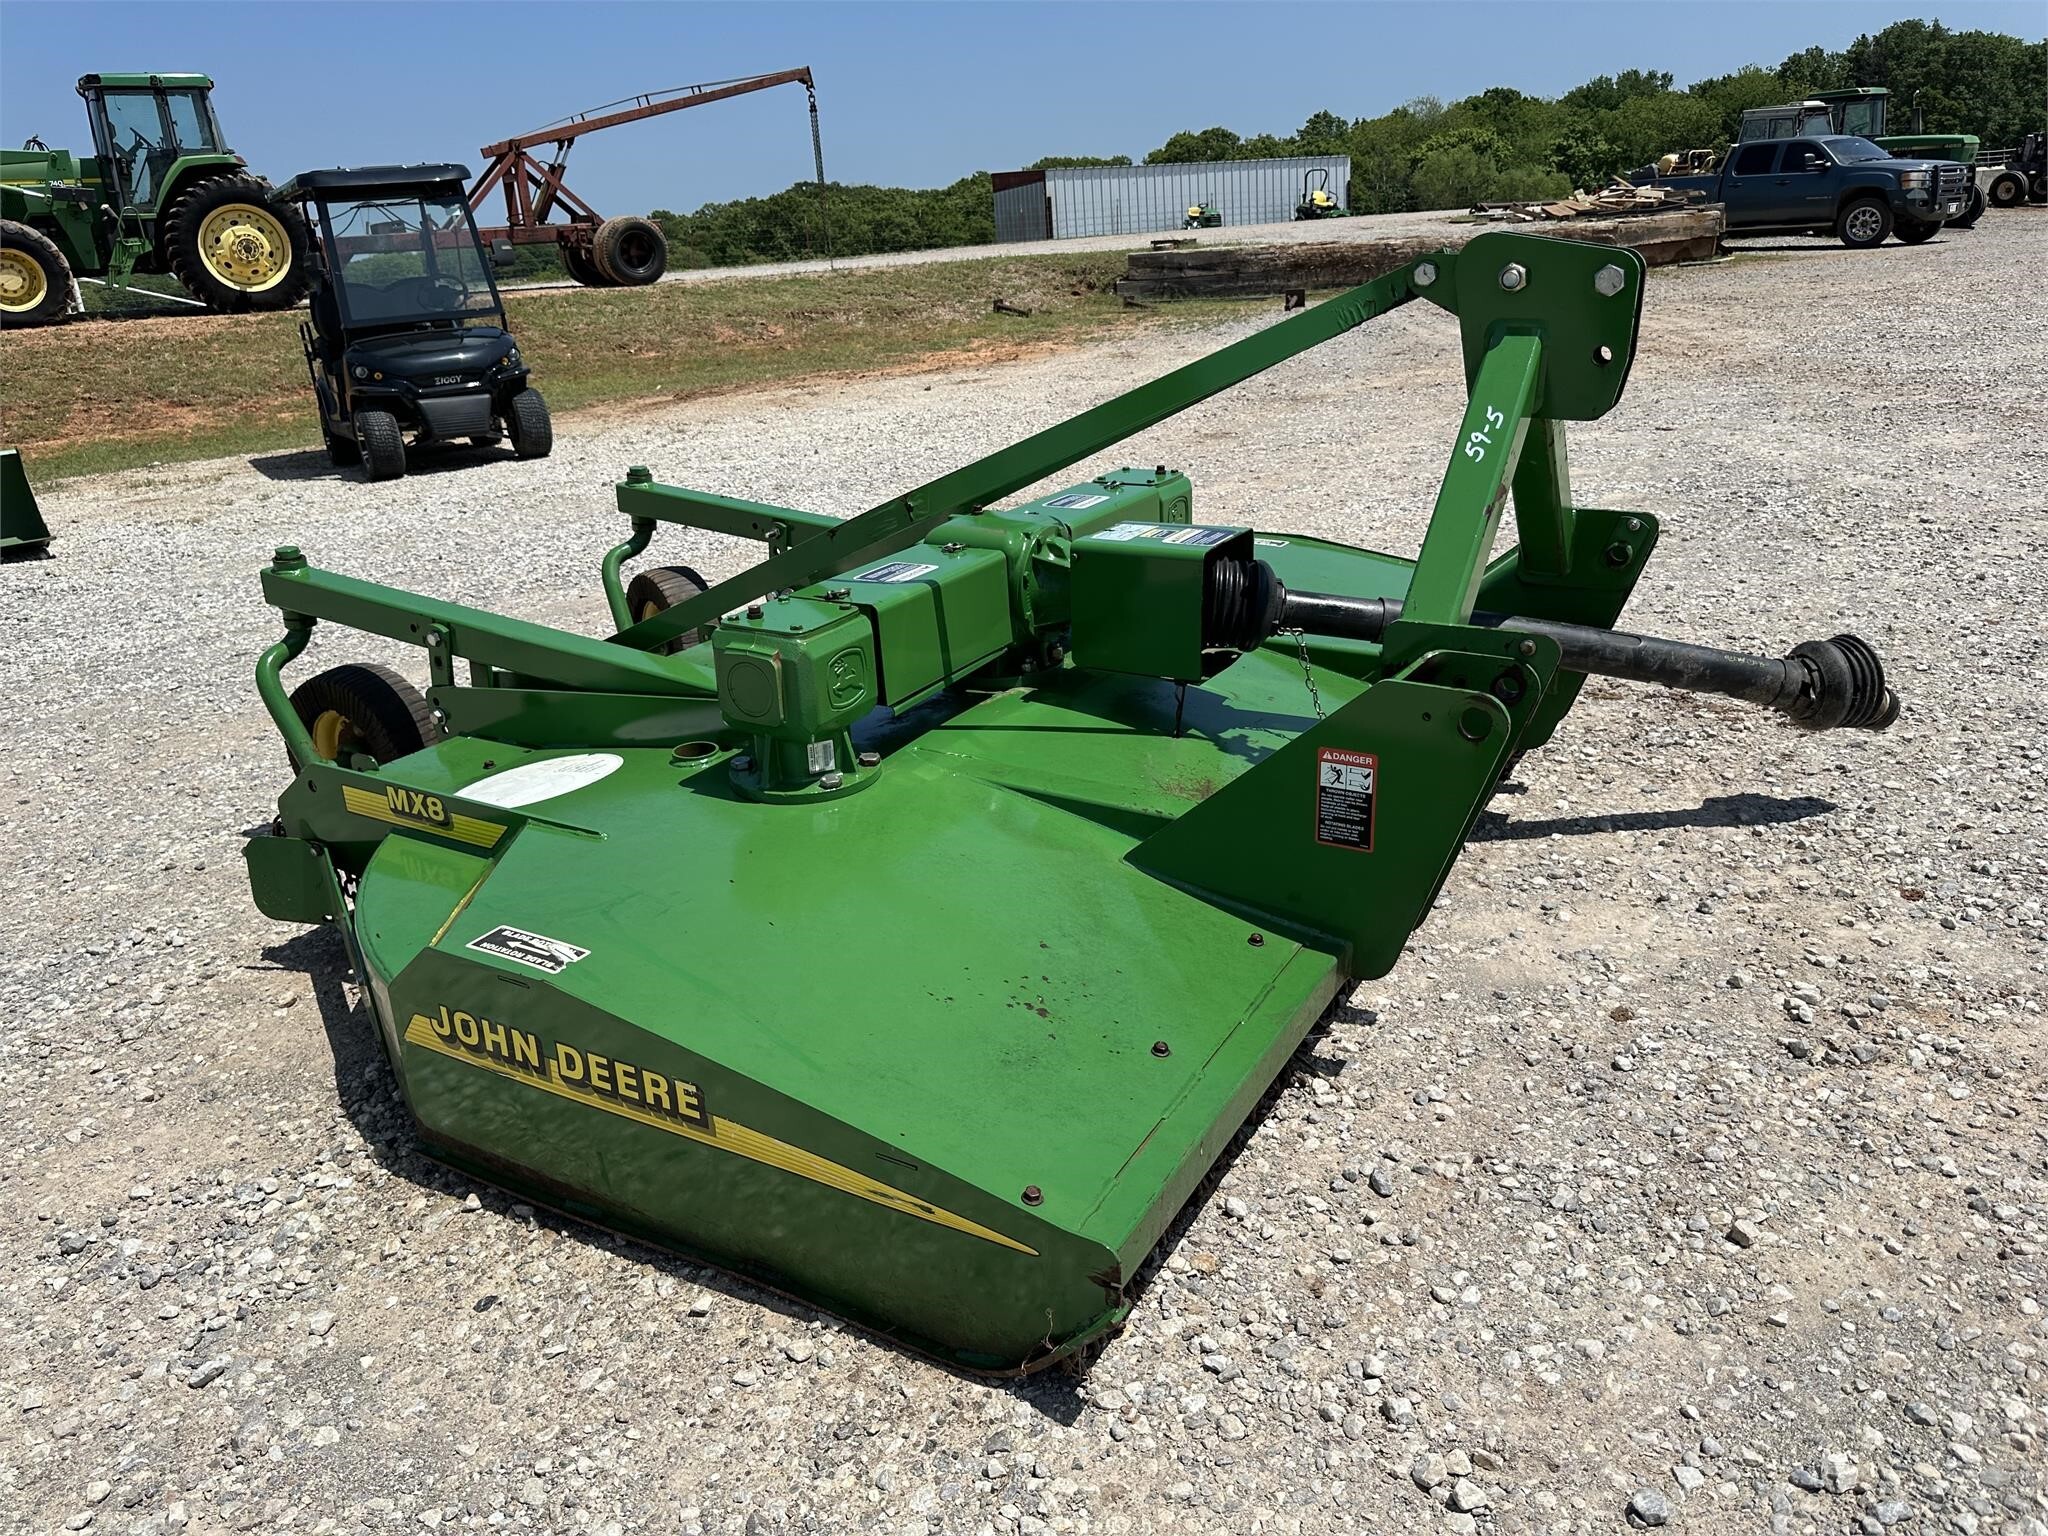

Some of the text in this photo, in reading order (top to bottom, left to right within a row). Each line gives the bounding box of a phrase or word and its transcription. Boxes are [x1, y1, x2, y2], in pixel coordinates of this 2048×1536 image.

[434, 375, 462, 385] ZIGGY
[465, 405, 504, 463] 59-5
[1333, 752, 1373, 765] DANGER
[385, 785, 446, 823] MX8
[501, 930, 533, 942] BLADE
[480, 942, 526, 959] ROTATION
[430, 1004, 702, 1119] JOHN DEERE
